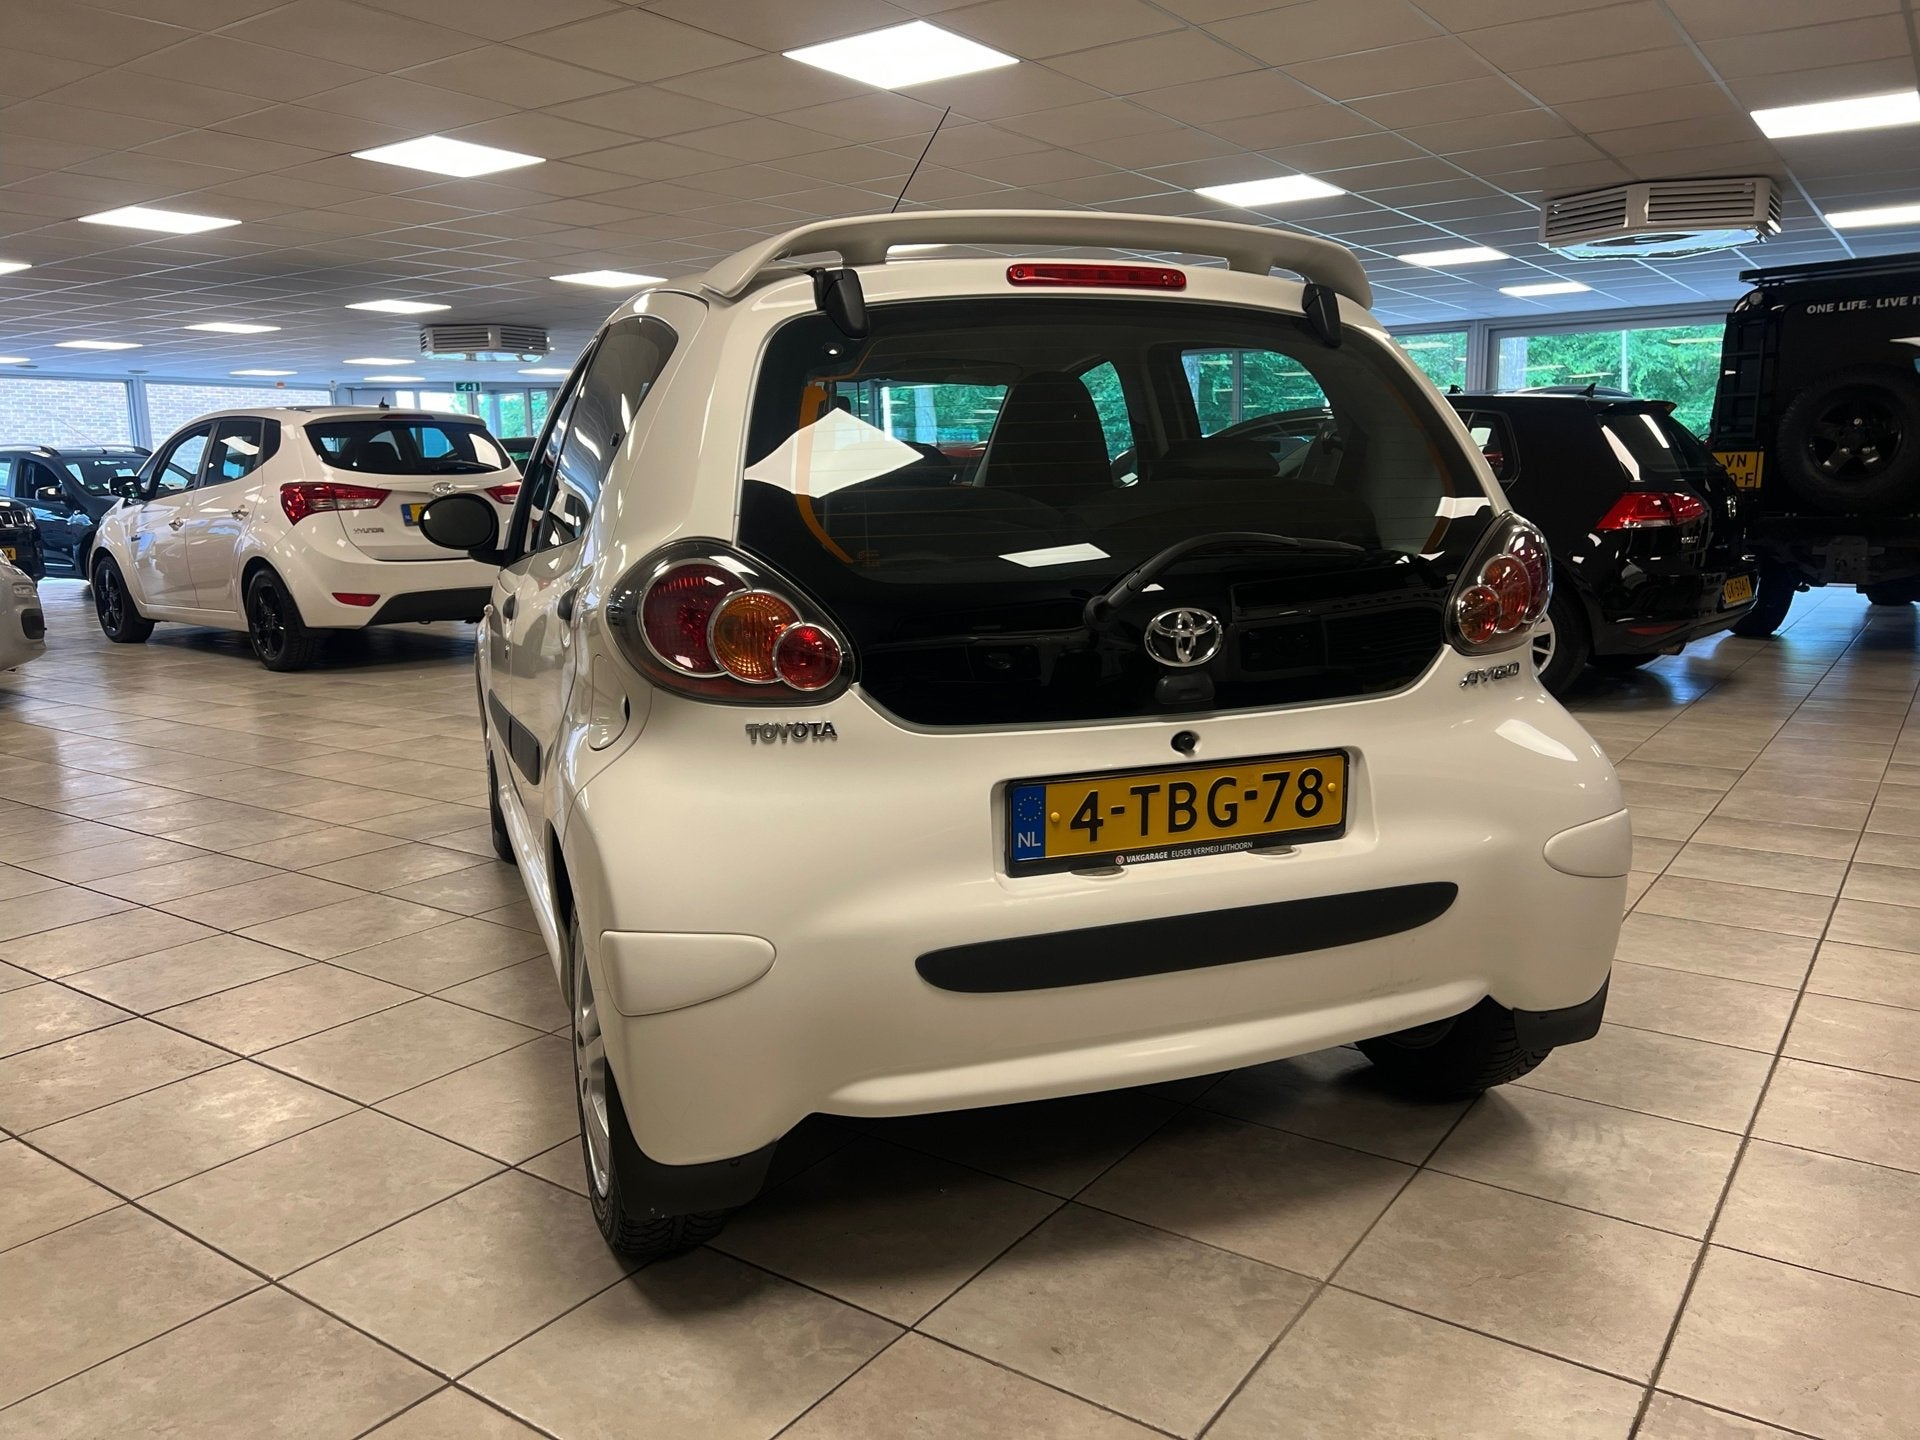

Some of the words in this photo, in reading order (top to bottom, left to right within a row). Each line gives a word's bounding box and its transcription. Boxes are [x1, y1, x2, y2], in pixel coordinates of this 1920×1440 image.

[1806, 303, 1835, 314] ONE
[1838, 300, 1872, 312] LIFE.
[1876, 296, 1909, 308] LIVE
[1726, 454, 1747, 468] VN
[1459, 661, 1520, 688] AYGO
[745, 721, 838, 745] TOYOTA
[1069, 767, 1324, 843] 4-TBG-78
[1018, 831, 1042, 849] NL
[1126, 851, 1168, 863] VAKGARAGE
[1171, 848, 1192, 858] EUSER
[1220, 841, 1253, 852] UITHOORN
